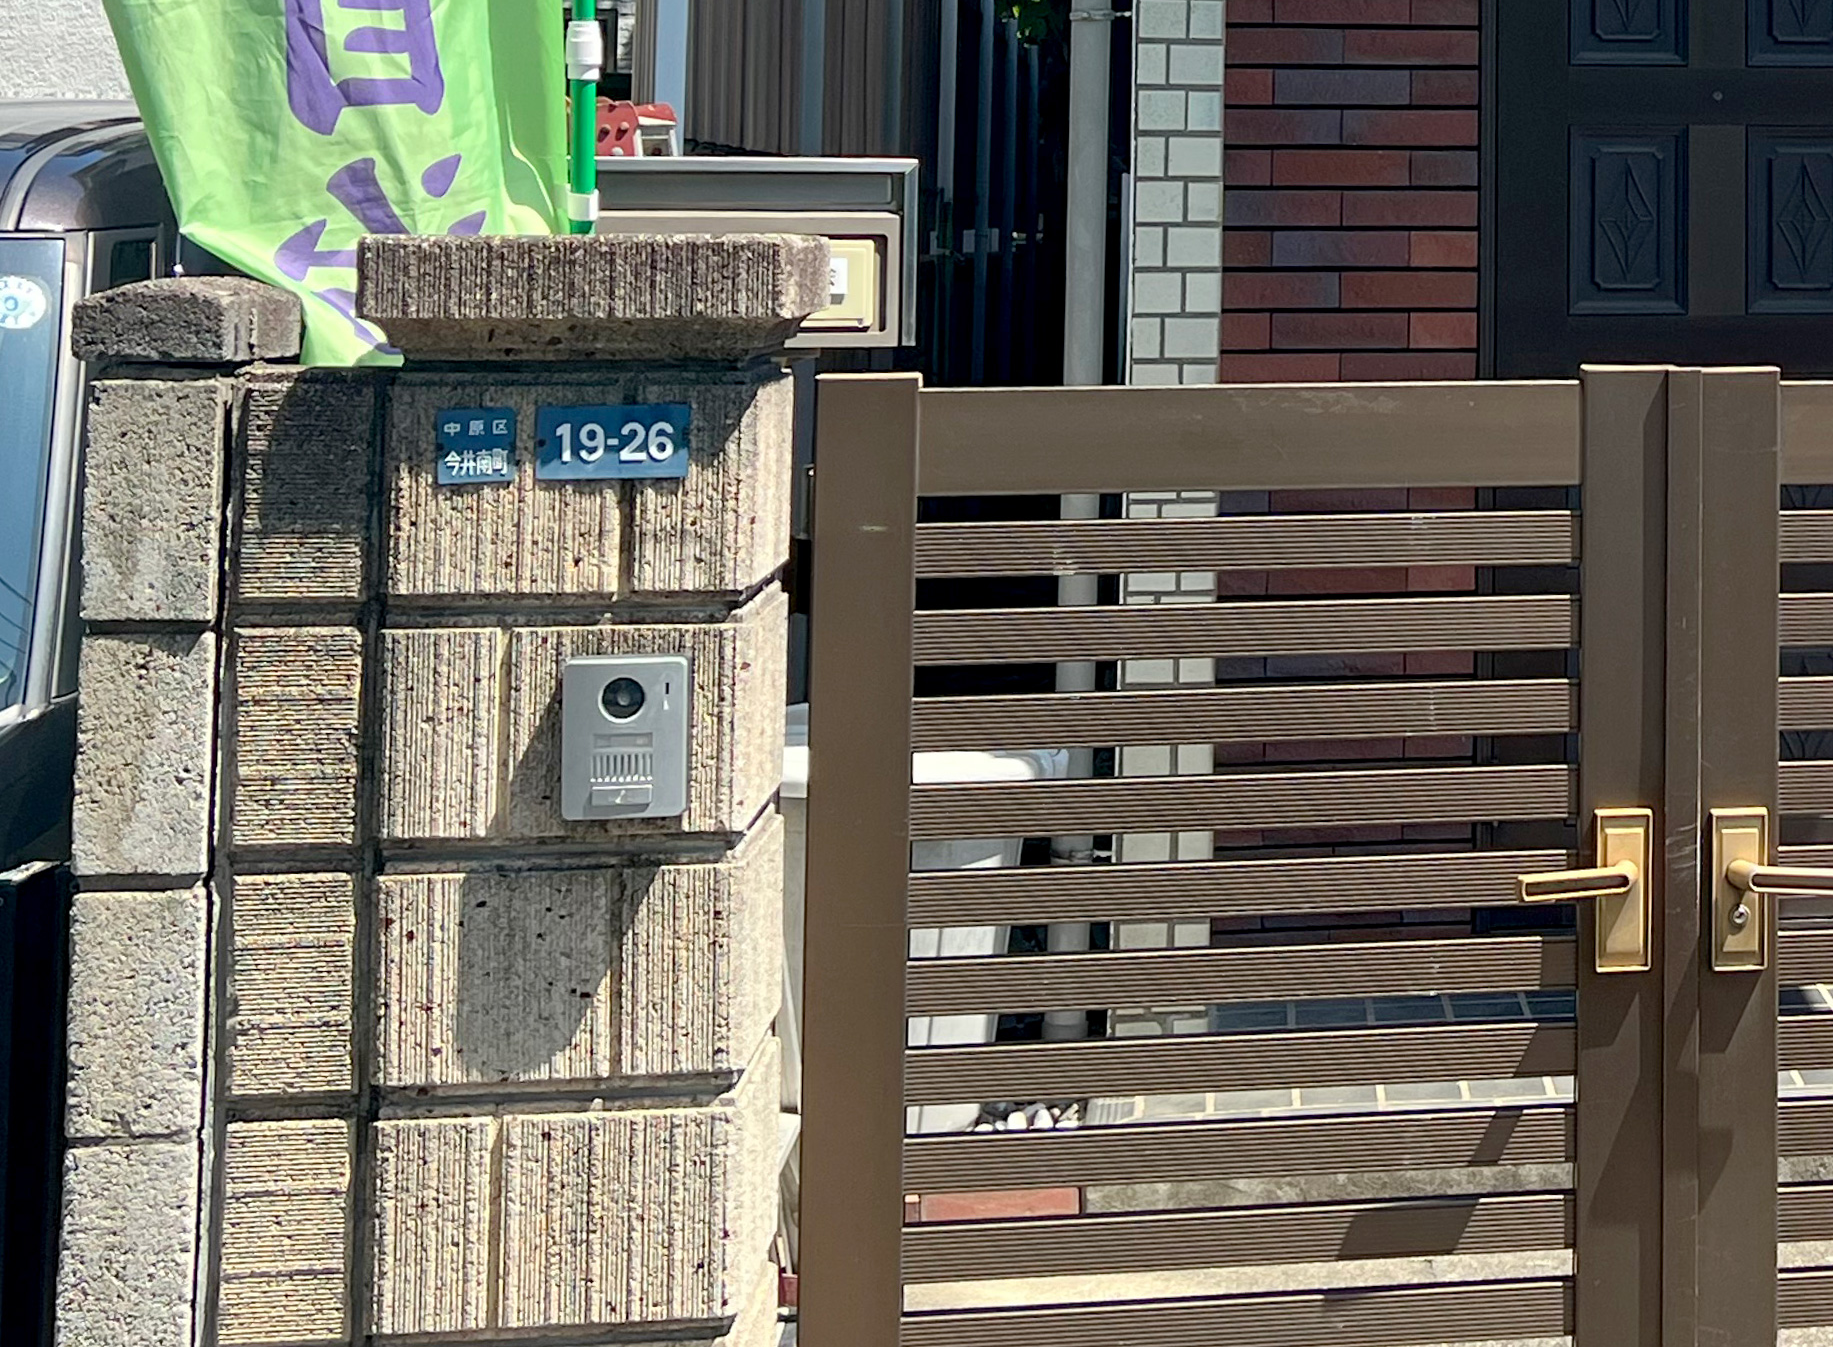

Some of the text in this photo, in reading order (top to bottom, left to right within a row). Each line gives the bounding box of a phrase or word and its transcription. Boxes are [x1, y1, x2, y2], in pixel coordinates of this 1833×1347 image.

[443, 418, 508, 437] 中原区
[555, 421, 675, 463] 19-26
[444, 447, 509, 476] 今井南町
